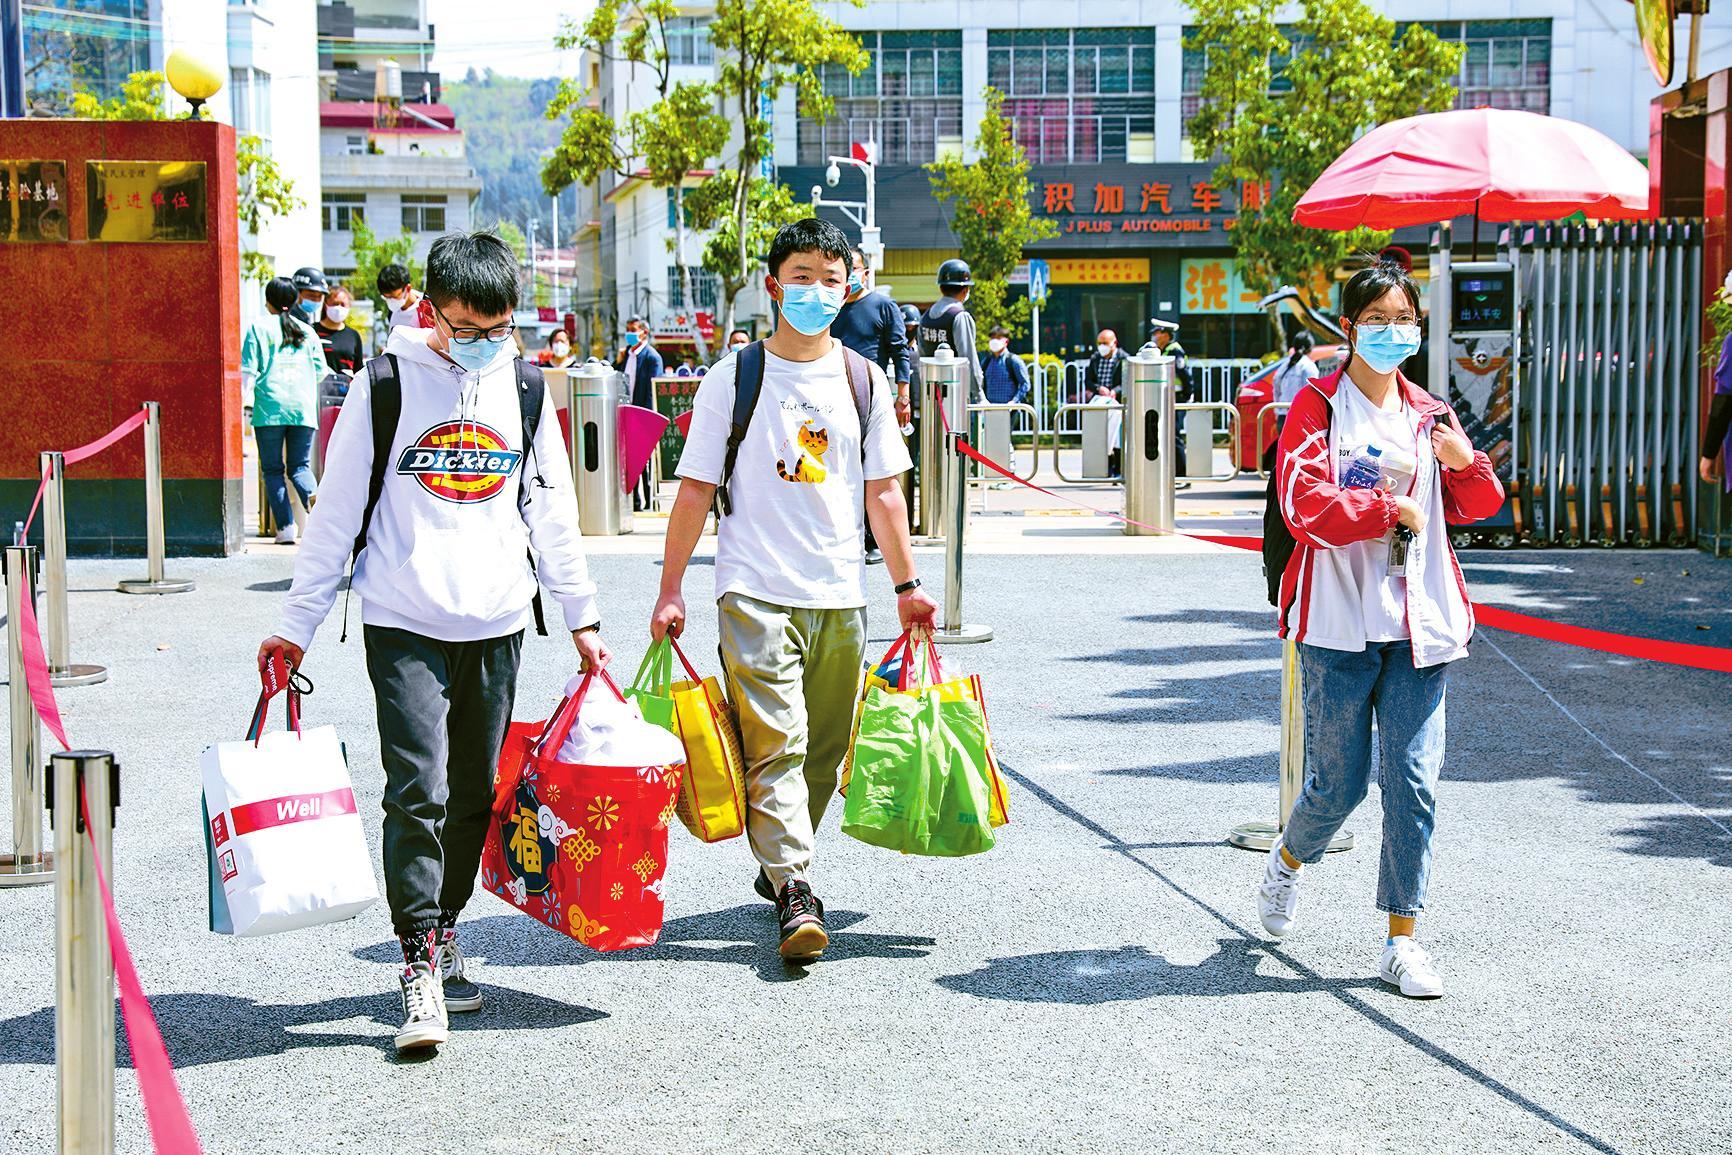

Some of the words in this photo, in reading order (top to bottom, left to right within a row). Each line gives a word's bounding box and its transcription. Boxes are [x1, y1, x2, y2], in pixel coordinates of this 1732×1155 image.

[1066, 221, 1075, 232] J
[1077, 221, 1112, 232] PLUS
[1121, 219, 1211, 232] AUTOMOBILE
[1461, 308, 1501, 321] 出入平安
[409, 451, 512, 471] Dickies
[267, 656, 278, 692] Supreme
[276, 797, 321, 821] Well
[509, 806, 542, 874] 福
